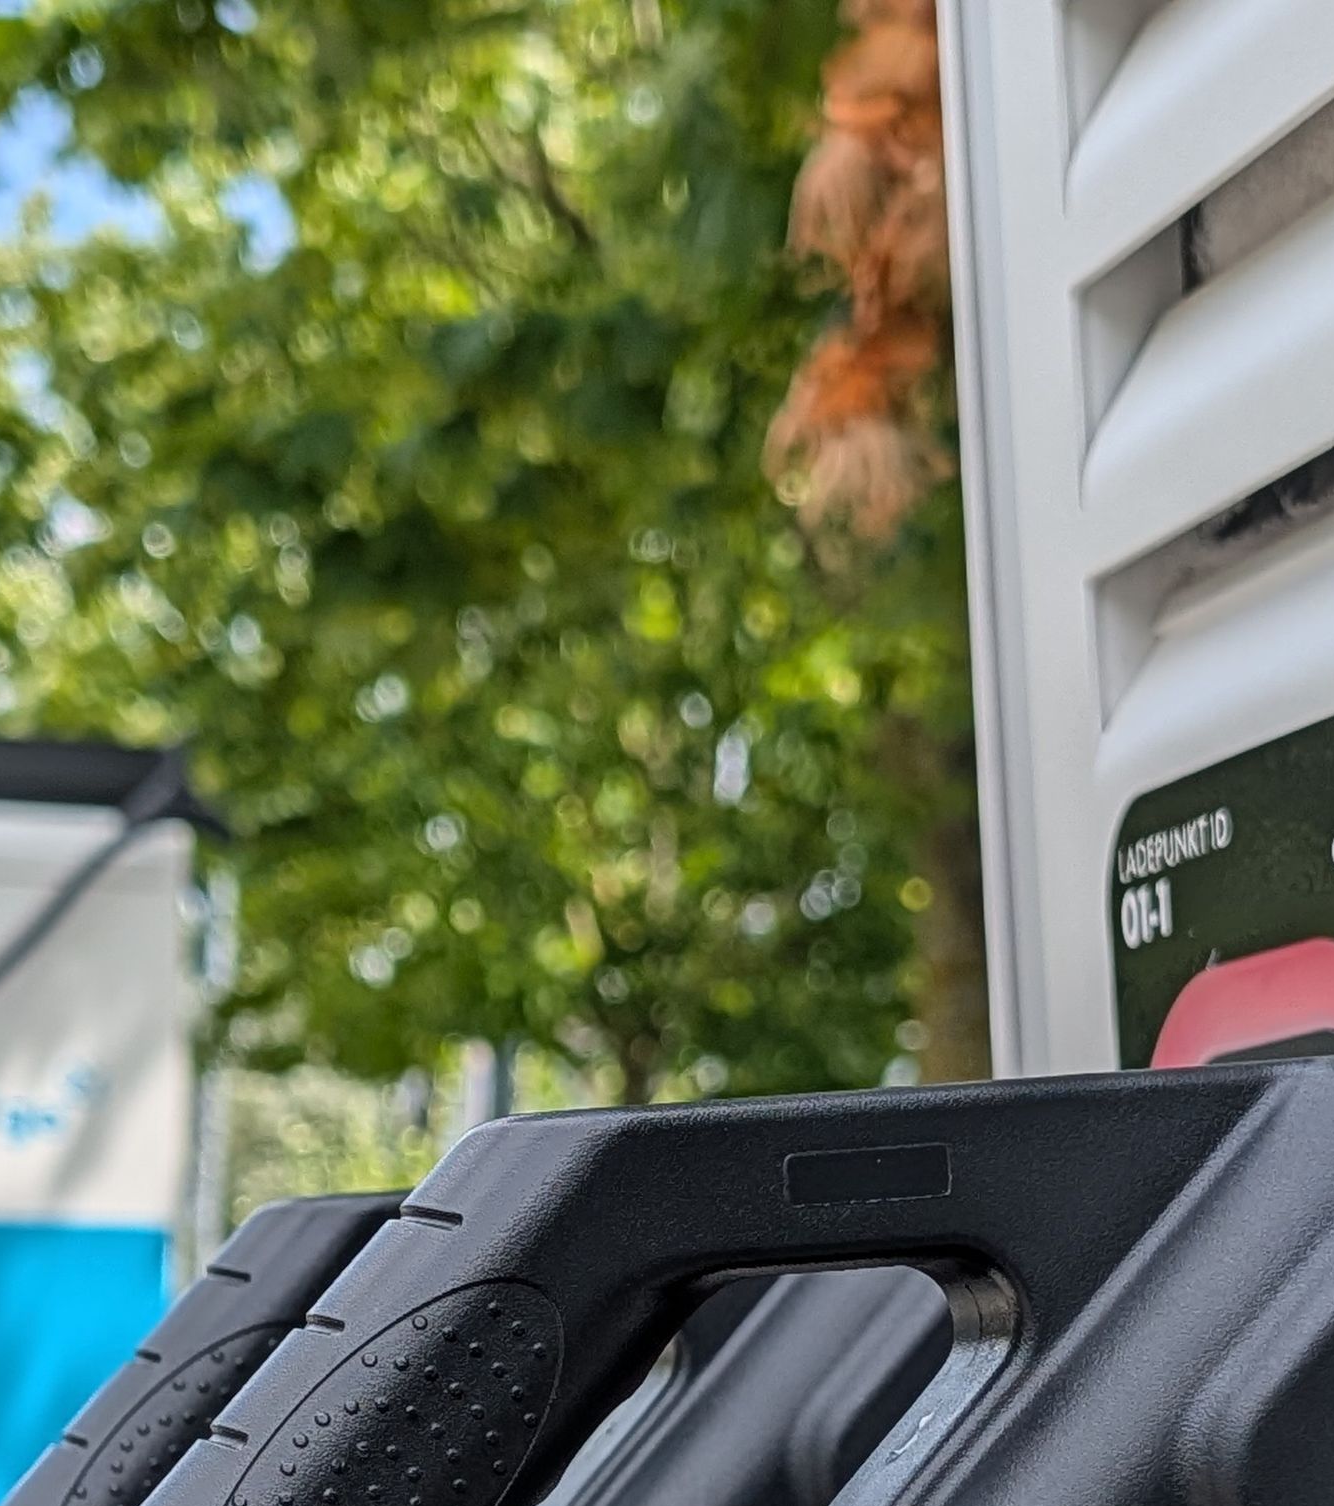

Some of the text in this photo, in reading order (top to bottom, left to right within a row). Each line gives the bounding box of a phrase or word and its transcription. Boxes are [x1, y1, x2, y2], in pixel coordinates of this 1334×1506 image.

[1119, 807, 1233, 883] LADEPUNKT ID
[1121, 878, 1172, 948] 01-1
